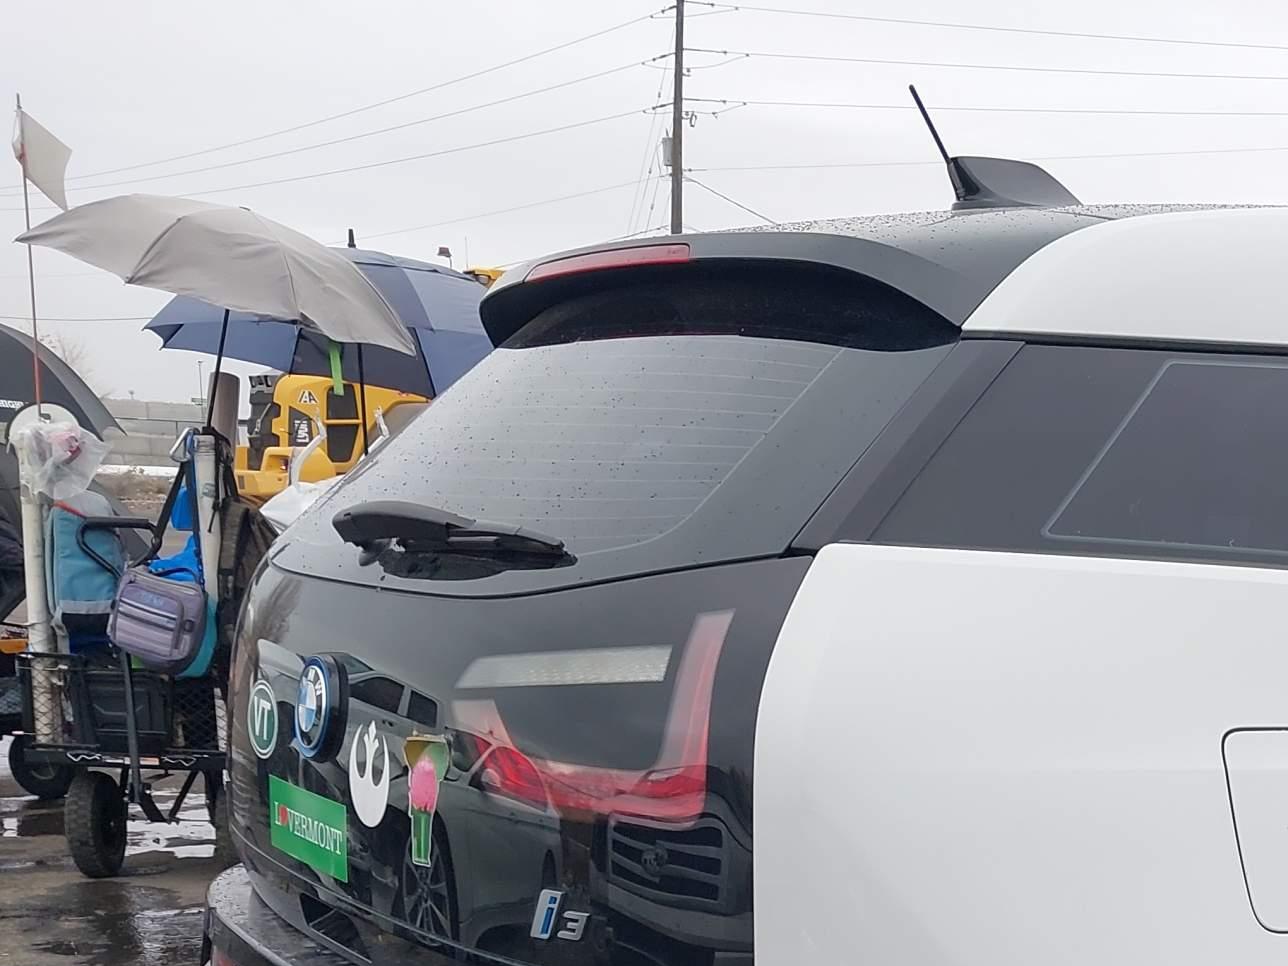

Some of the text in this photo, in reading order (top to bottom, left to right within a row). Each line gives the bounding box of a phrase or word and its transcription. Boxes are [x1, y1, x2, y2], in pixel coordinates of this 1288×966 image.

[254, 695, 272, 741] VT
[286, 807, 343, 855] VERMONT
[530, 888, 591, 941] i3
